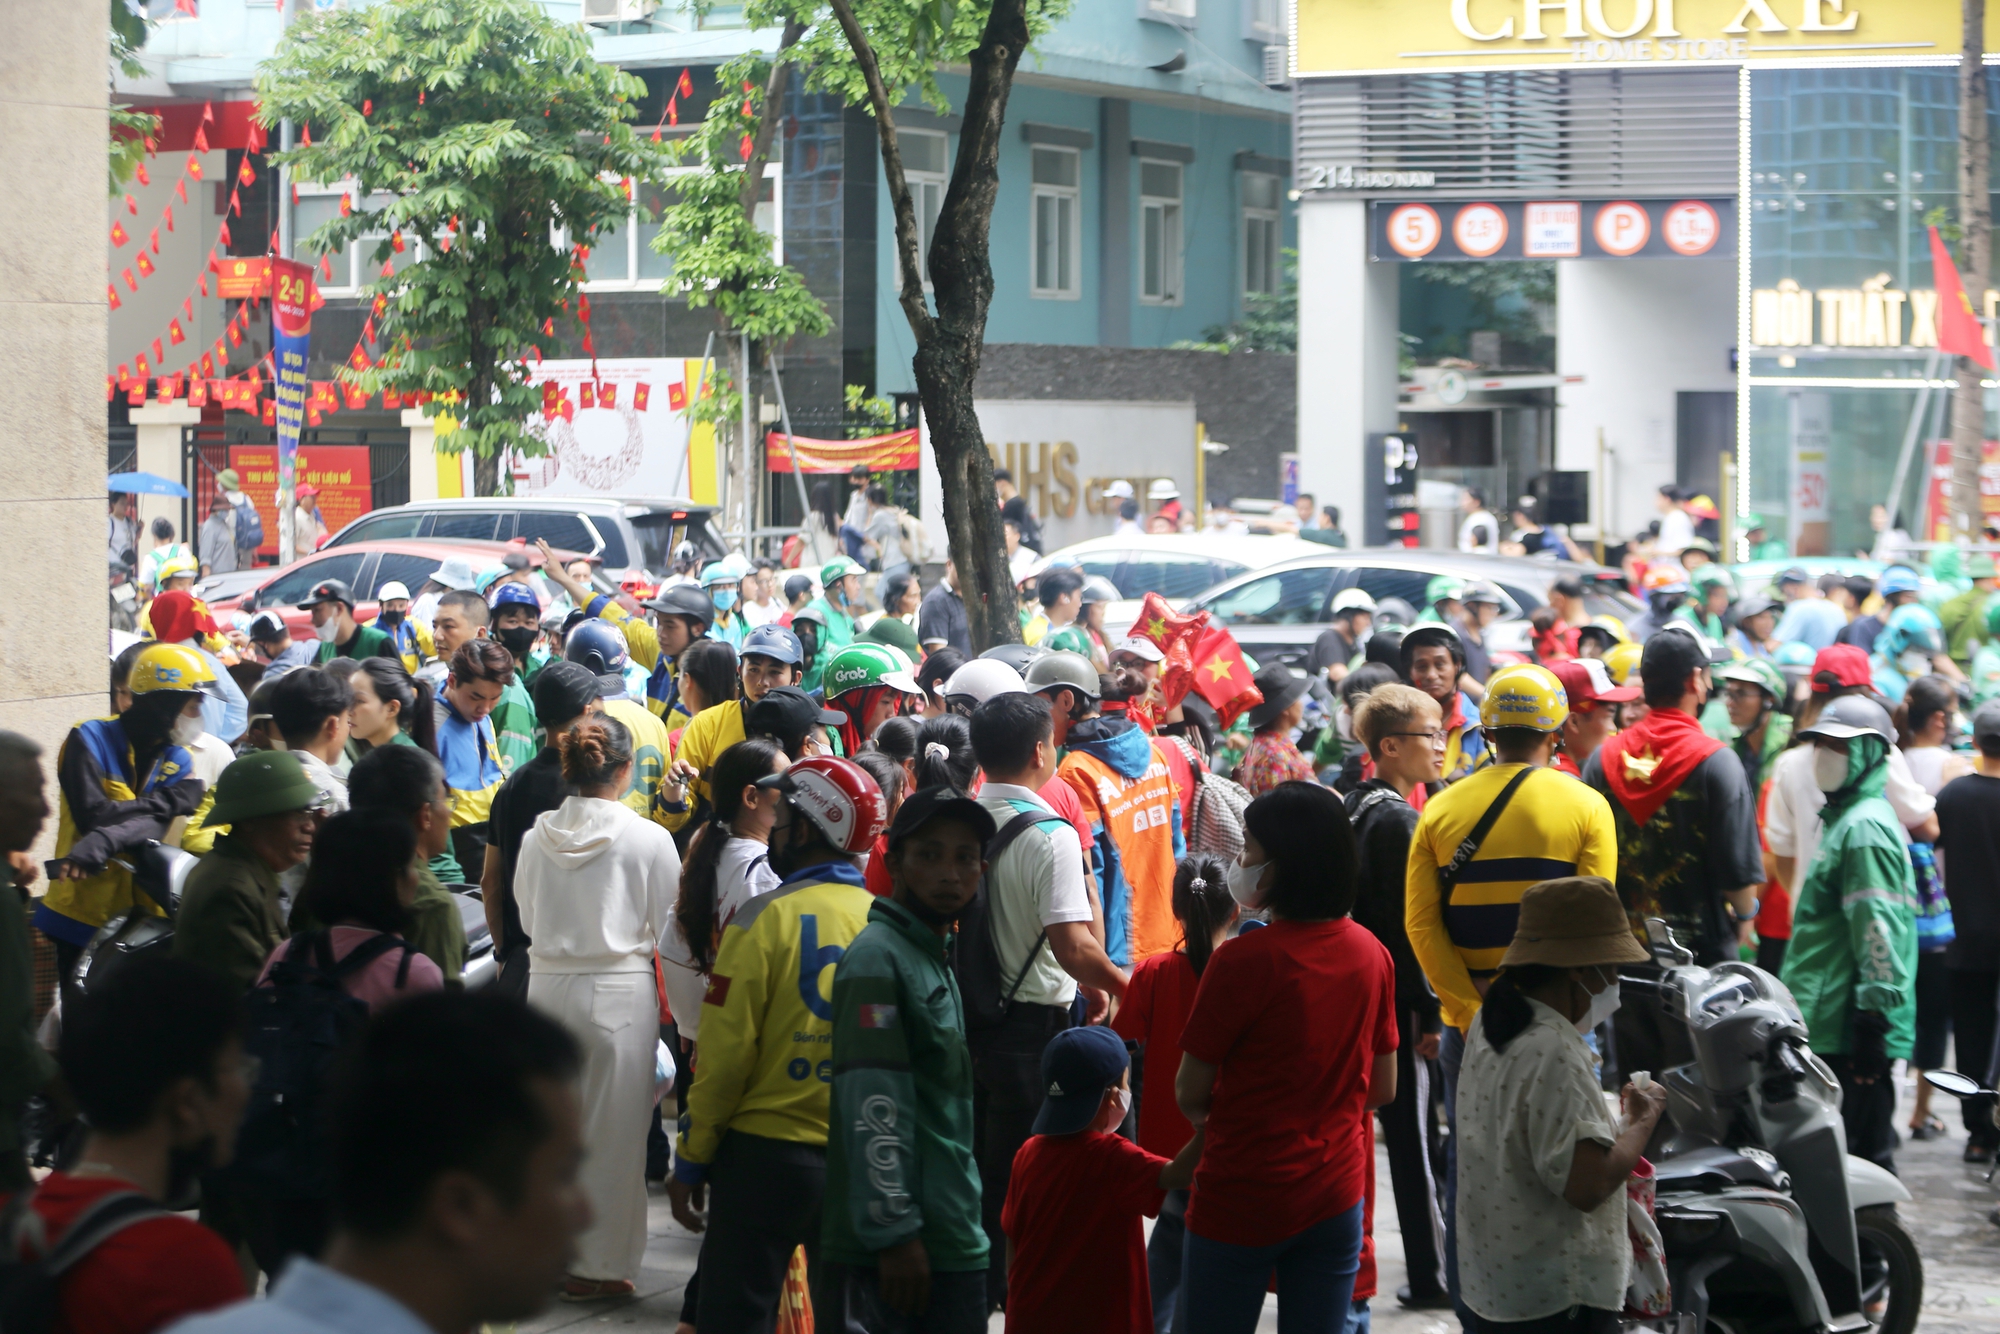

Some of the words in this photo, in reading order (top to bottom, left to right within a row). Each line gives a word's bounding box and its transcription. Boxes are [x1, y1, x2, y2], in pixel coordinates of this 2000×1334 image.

[1571, 40, 1652, 62] HOME
[1658, 38, 1748, 60] STORE
[1309, 166, 1353, 189] 214
[1396, 171, 1435, 187] NAM
[1406, 216, 1423, 243] 5
[1615, 214, 1633, 242] P
[278, 274, 305, 305] 2-9
[1909, 289, 1943, 347] X
[156, 664, 183, 683] be
[835, 668, 866, 683] Grab
[1521, 694, 1539, 703] NAY
